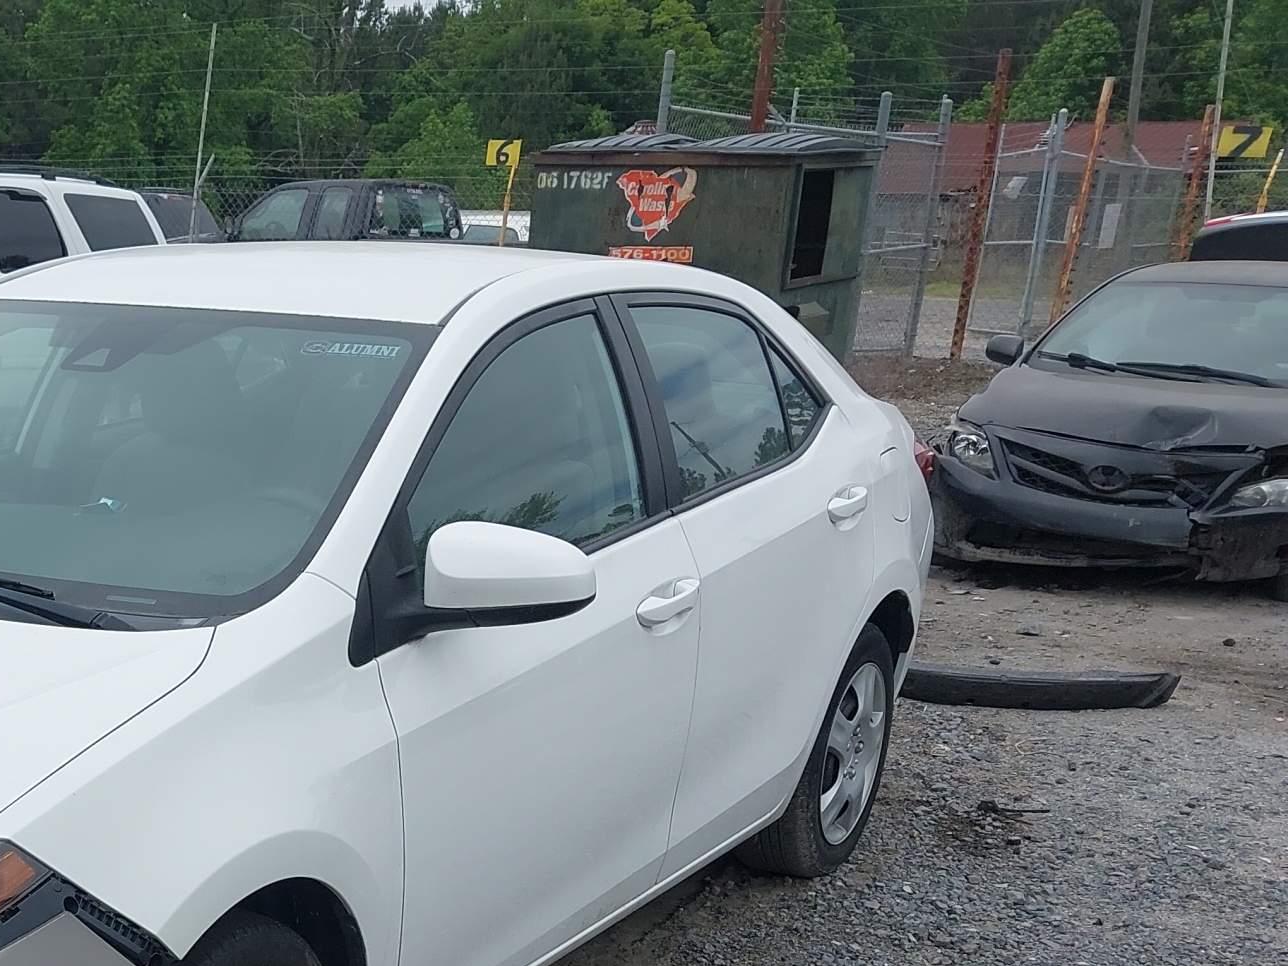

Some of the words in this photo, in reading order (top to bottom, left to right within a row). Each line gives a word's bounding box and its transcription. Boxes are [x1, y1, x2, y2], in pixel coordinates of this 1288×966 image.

[495, 137, 514, 167] 6
[1227, 125, 1264, 158] 7
[638, 197, 675, 212] Wase
[326, 342, 401, 357] ALUMNI
